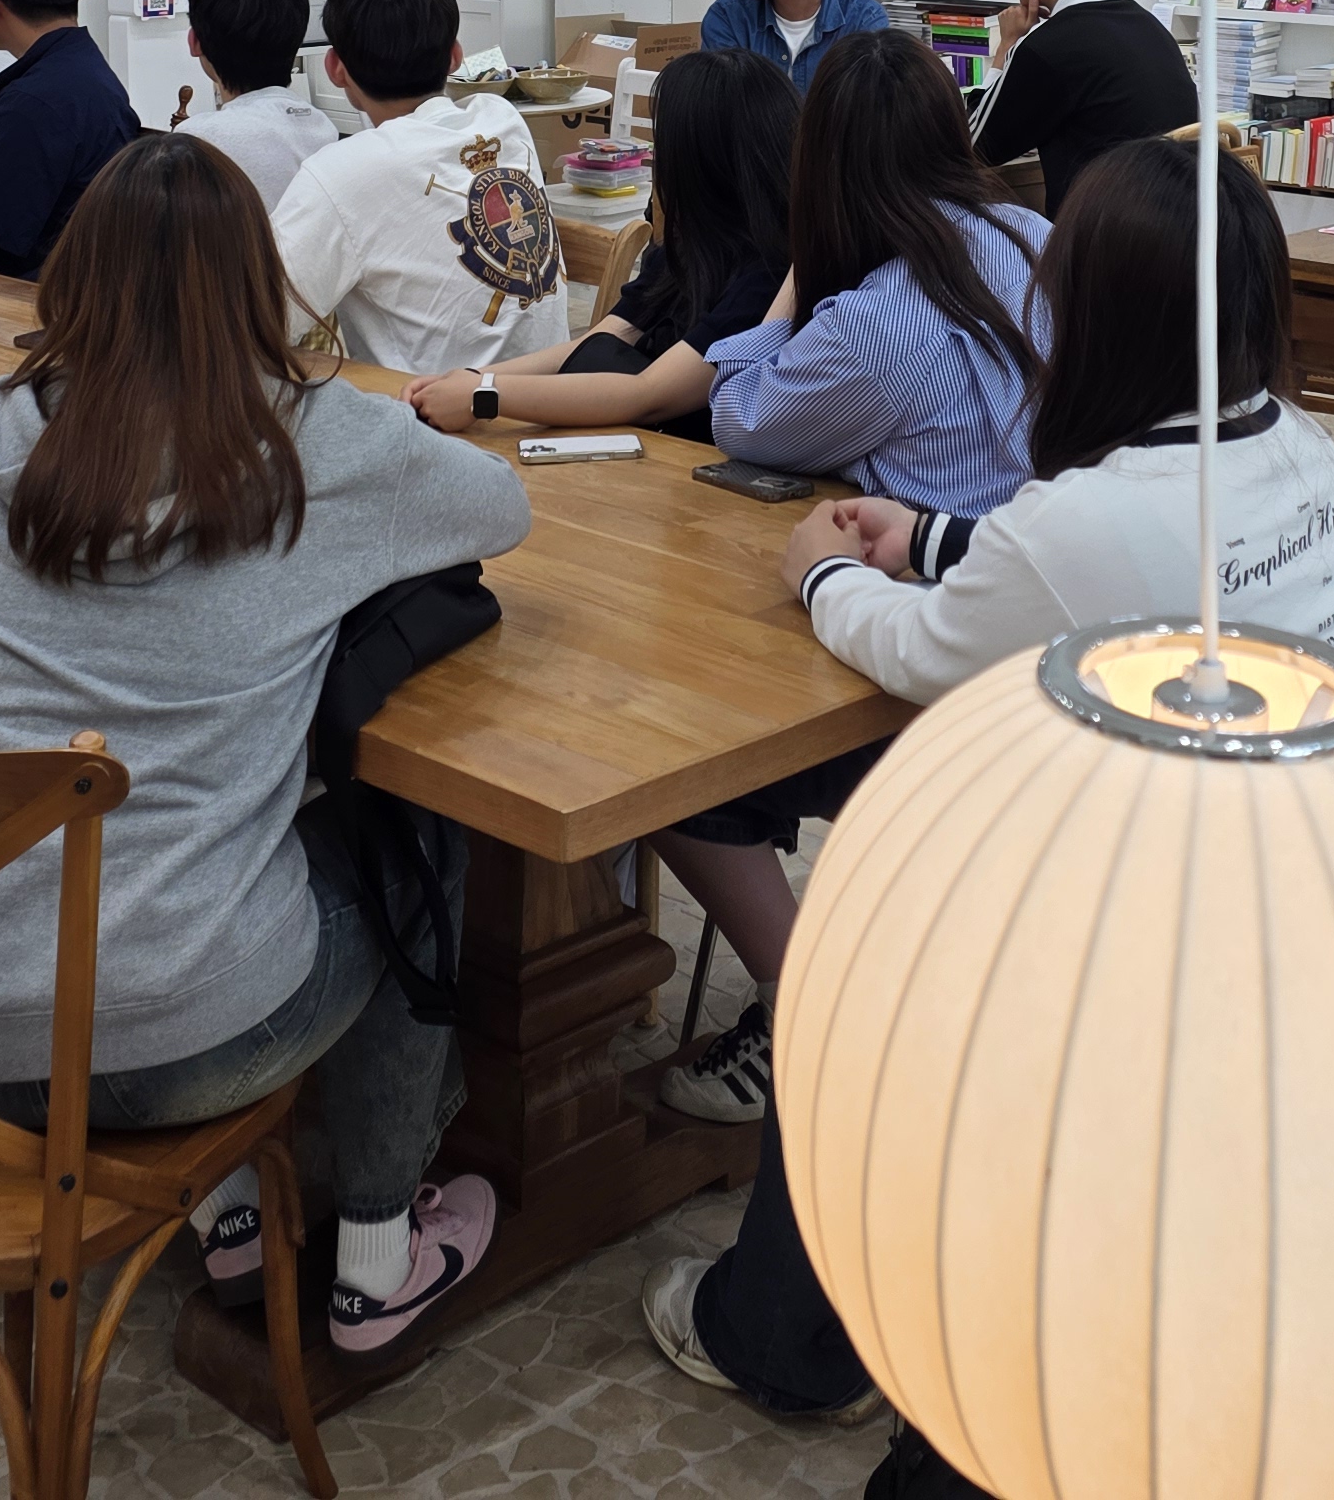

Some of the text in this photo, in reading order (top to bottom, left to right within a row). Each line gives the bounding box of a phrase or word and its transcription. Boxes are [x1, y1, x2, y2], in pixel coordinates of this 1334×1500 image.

[471, 168, 550, 255] KANGOL STYLE BEGINNING
[482, 266, 511, 290] SINCE
[1217, 516, 1315, 596] Graphical
[218, 1209, 256, 1239] NIKE
[333, 1290, 363, 1314] NIKE
